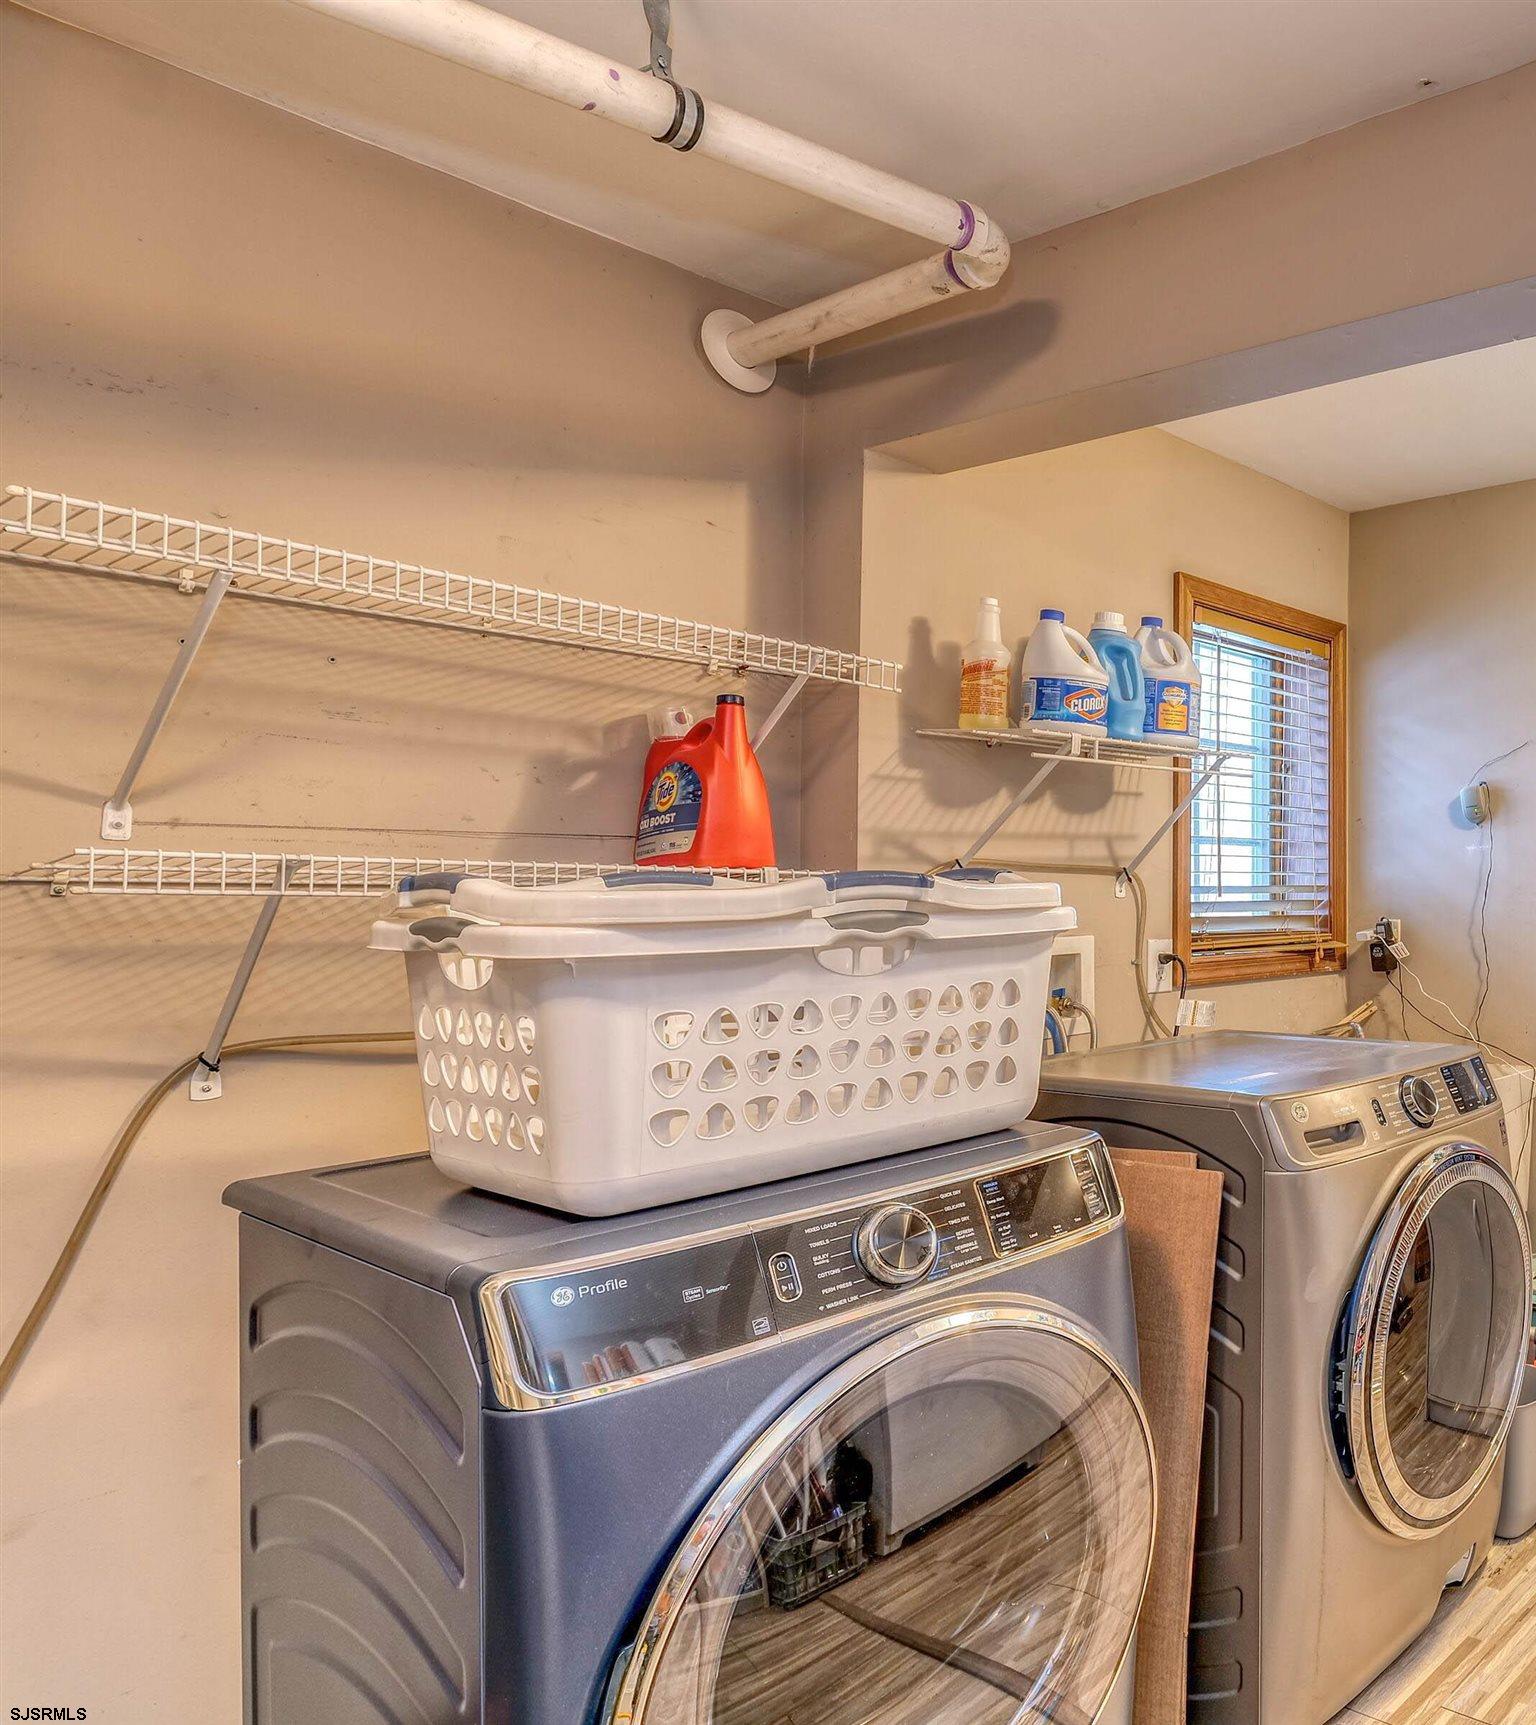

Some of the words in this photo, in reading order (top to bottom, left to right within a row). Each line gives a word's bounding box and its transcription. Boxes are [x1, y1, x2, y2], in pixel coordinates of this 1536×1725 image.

[1071, 697, 1106, 711] CLOROX
[656, 781, 675, 804] Tide
[650, 812, 677, 827] BOOST
[808, 1238, 830, 1248] TOWELS
[817, 1267, 841, 1279] COTTONS
[578, 1278, 628, 1298] Profile
[847, 1294, 859, 1302] LINK
